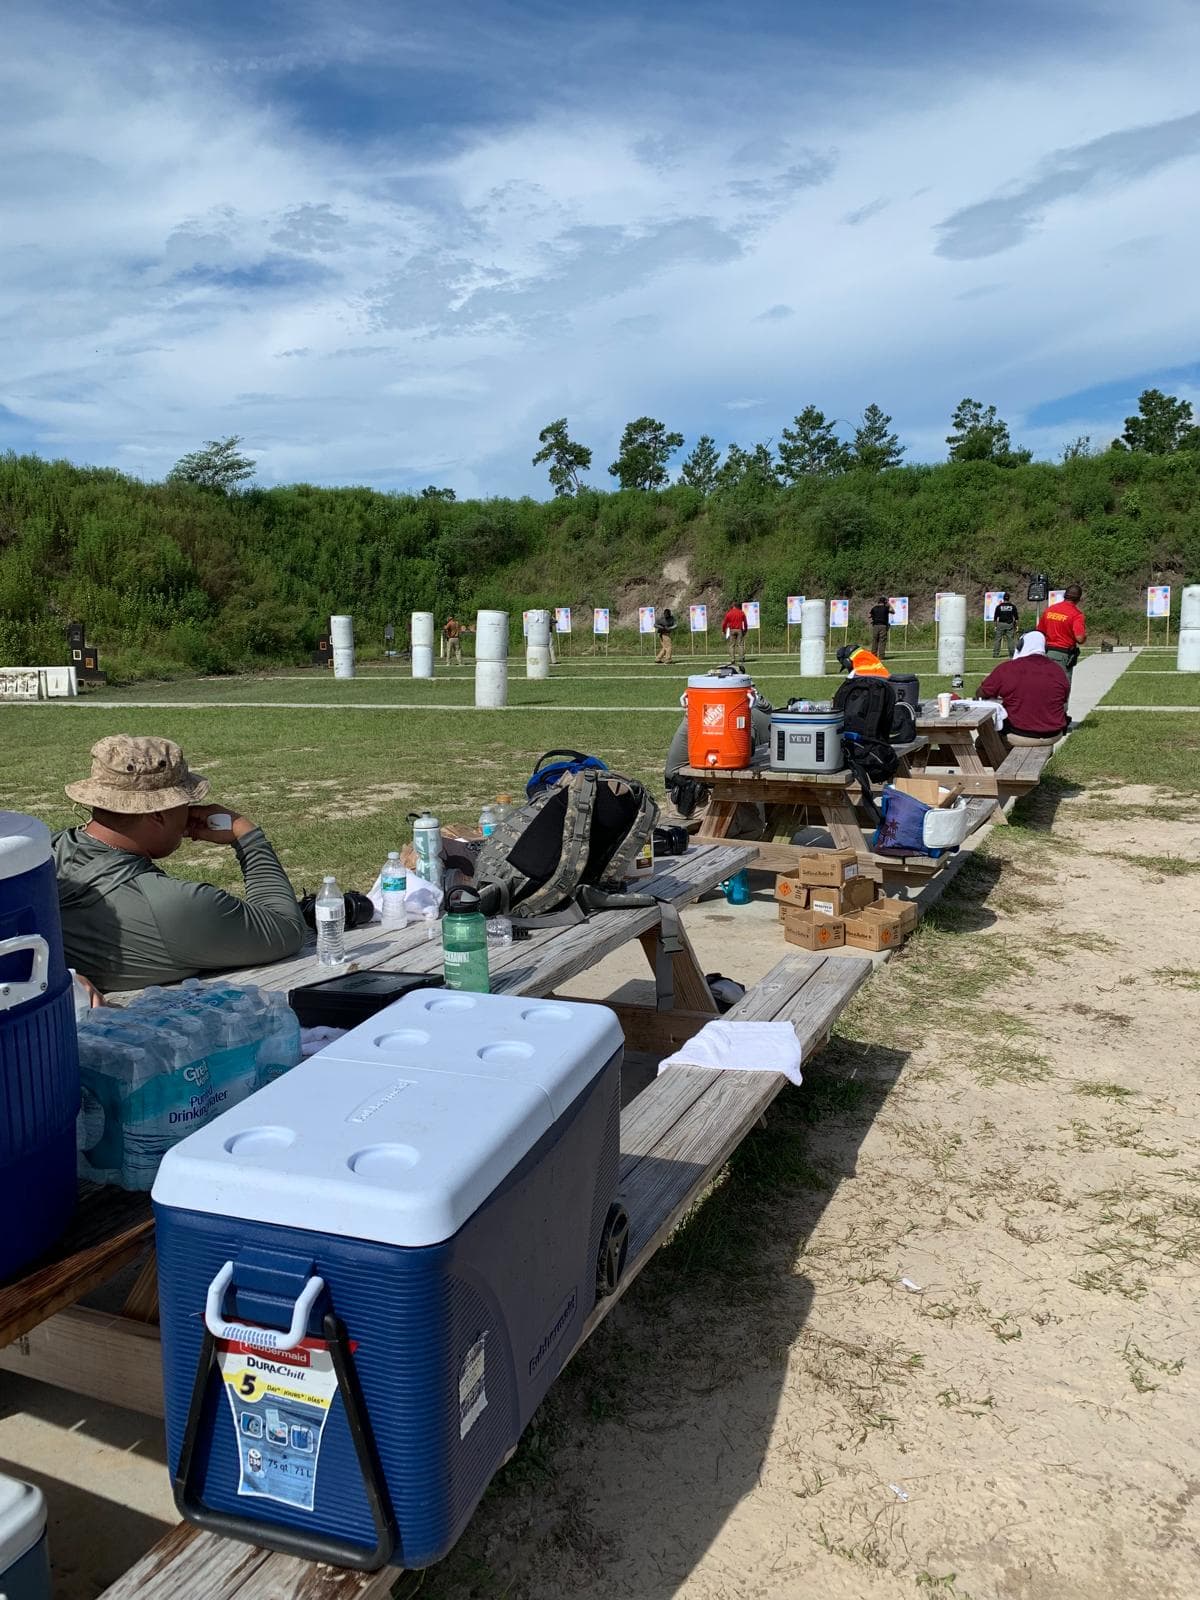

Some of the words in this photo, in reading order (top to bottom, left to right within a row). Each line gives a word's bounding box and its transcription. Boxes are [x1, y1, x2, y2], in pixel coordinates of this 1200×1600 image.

[1046, 611, 1069, 622] SHERIFF
[791, 735, 810, 743] YETI
[240, 1374, 257, 1396] 5
[268, 1459, 278, 1469] 75
